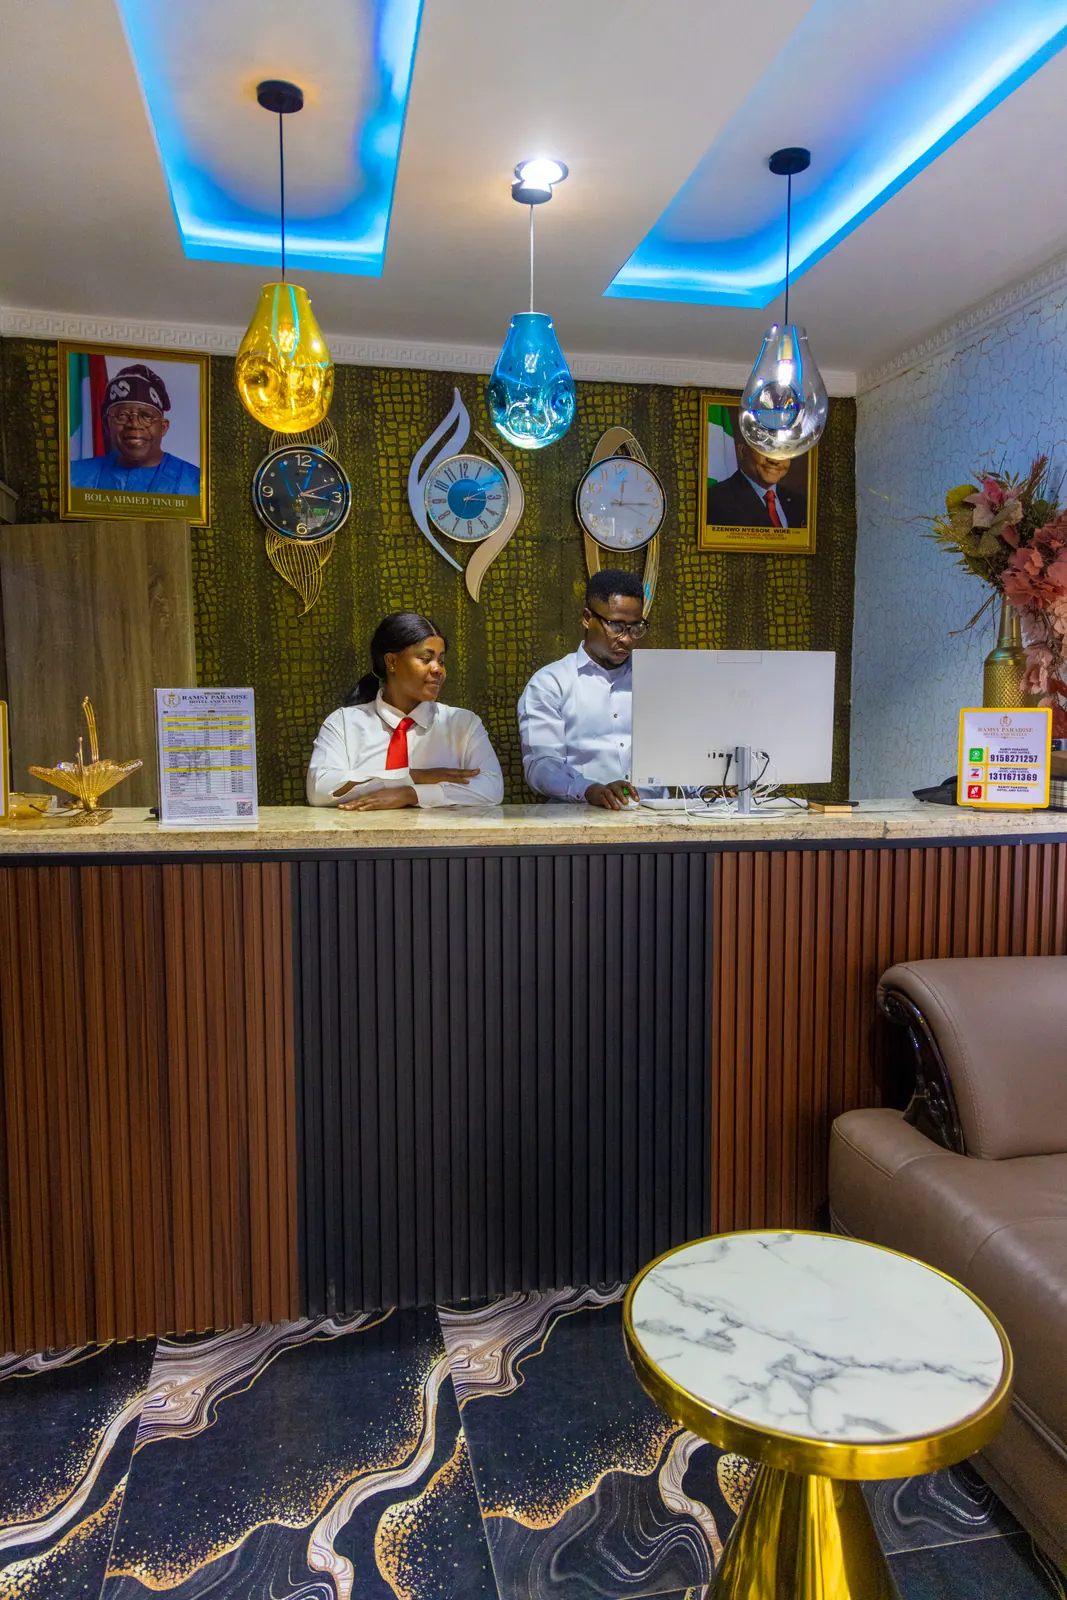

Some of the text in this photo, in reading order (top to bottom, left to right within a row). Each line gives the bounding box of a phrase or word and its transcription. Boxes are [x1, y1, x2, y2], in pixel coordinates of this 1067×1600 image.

[295, 454, 312, 467] 12
[444, 467, 457, 483] 11
[460, 462, 469, 478] 12
[475, 466, 482, 480] 1
[600, 469, 608, 480] 11
[262, 485, 274, 498] 9
[434, 480, 450, 492] 10
[588, 482, 602, 494] 10
[644, 480, 654, 492] 2
[84, 493, 110, 502] BOLA
[112, 495, 149, 505] AHMED
[151, 498, 188, 508] TINUBU
[331, 491, 342, 503] 3
[652, 498, 659, 510] 3
[485, 508, 499, 516] 4
[452, 518, 460, 532] 7
[478, 516, 488, 530] 5
[647, 514, 656, 524] 4
[296, 522, 308, 534] 6
[467, 520, 472, 536] 6
[636, 528, 644, 540] 5
[990, 754, 1038, 763] 9158271257
[989, 772, 1038, 781] 1311671369
